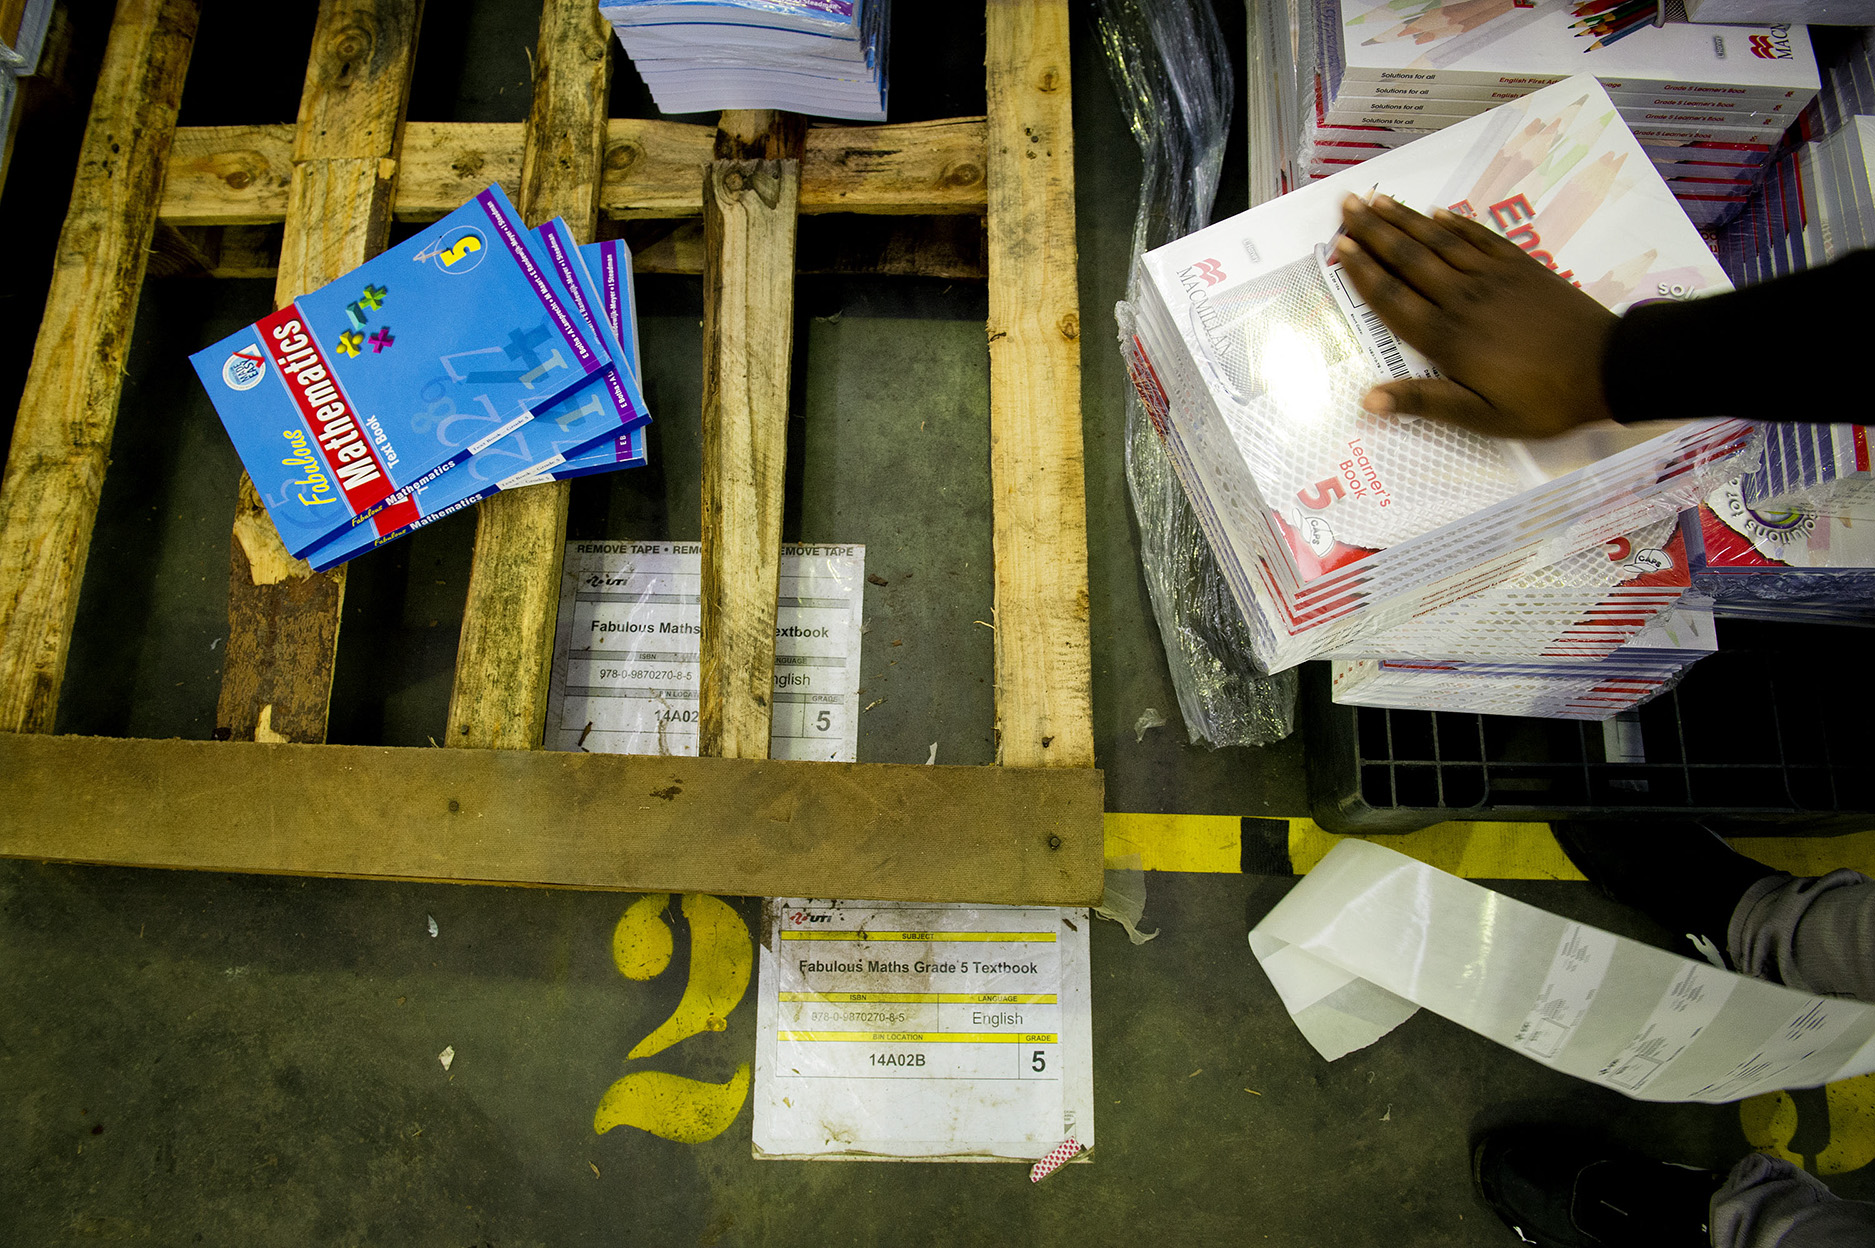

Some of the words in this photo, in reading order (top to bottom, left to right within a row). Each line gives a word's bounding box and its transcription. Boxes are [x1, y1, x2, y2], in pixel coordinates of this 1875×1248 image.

[487, 200, 506, 226] Steadman
[440, 236, 481, 267] 5
[505, 230, 534, 273] Randewijk-Meyer
[548, 233, 564, 260] Steadman
[606, 254, 615, 284] Steadman
[535, 277, 548, 294] Maart
[544, 292, 552, 300] M
[563, 266, 586, 314] Randewijk-Meyer
[551, 302, 572, 331] Lamprecht
[1176, 266, 1233, 357] MACMILLAN
[574, 336, 586, 354] Botha
[234, 364, 247, 382] MADE
[243, 358, 259, 379] EASY
[273, 319, 381, 492] Mathematics
[614, 384, 626, 404] Botha
[366, 414, 388, 446] Book
[282, 429, 337, 507] Fabulous
[381, 444, 400, 470] Text
[1339, 460, 1367, 500] Book
[1348, 438, 1392, 508] Learner's
[352, 505, 383, 527] Fabulous
[385, 460, 456, 506] Mathematics
[1296, 476, 1346, 510] 5
[374, 529, 407, 547] Fabulous
[410, 493, 483, 530] Mathematics
[1310, 520, 1321, 545] CAPS
[577, 545, 627, 554] REMOVE
[631, 546, 660, 554] TAPE
[672, 546, 701, 554] REM
[780, 547, 820, 556] EMOVE
[824, 547, 854, 556] TAPE
[1638, 555, 1662, 568] CAPS
[591, 620, 654, 633] Fabulous
[659, 622, 700, 634] Maths
[775, 626, 829, 638] extbook
[600, 668, 692, 680] 978-0-9870270-8-5
[774, 674, 810, 687] nglish
[654, 710, 699, 722] 14A02
[816, 710, 831, 732] 5
[799, 960, 864, 974] Fabulous
[868, 960, 910, 974] Maths
[914, 960, 956, 974] Grade
[960, 961, 968, 974] 5
[972, 962, 1038, 975] Textbook
[594, 892, 753, 1145] 2
[811, 1012, 906, 1023] 978-0-9870270-8-5
[972, 1011, 1024, 1026] English
[869, 1054, 926, 1067] 14A02B
[1032, 1050, 1046, 1072] 5
